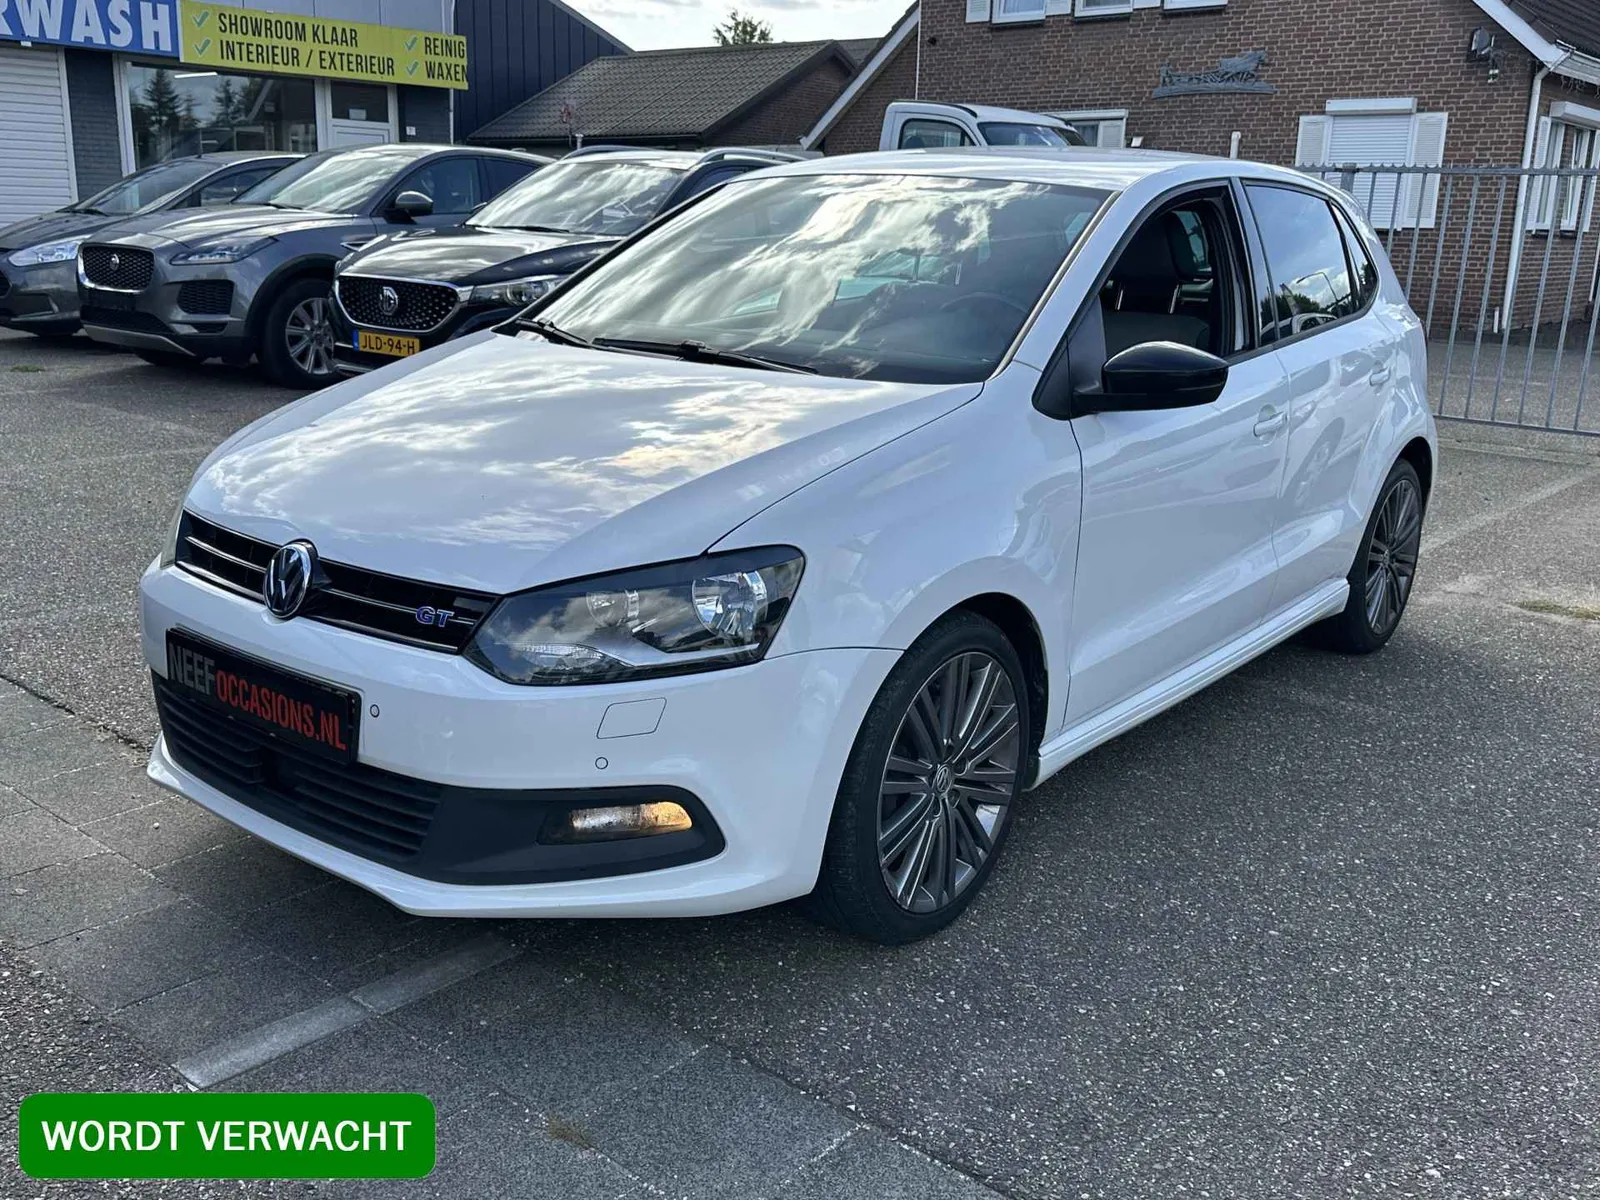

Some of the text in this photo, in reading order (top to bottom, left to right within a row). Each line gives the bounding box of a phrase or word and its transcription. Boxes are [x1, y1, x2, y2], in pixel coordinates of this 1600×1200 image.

[218, 12, 359, 48] SHOWROOM KLAAR
[219, 39, 301, 68] INTERIEUR
[319, 50, 396, 77] EXTERIEUR
[424, 36, 466, 59] REINIG
[362, 334, 416, 356] JLD-94-H
[415, 605, 454, 628] GT
